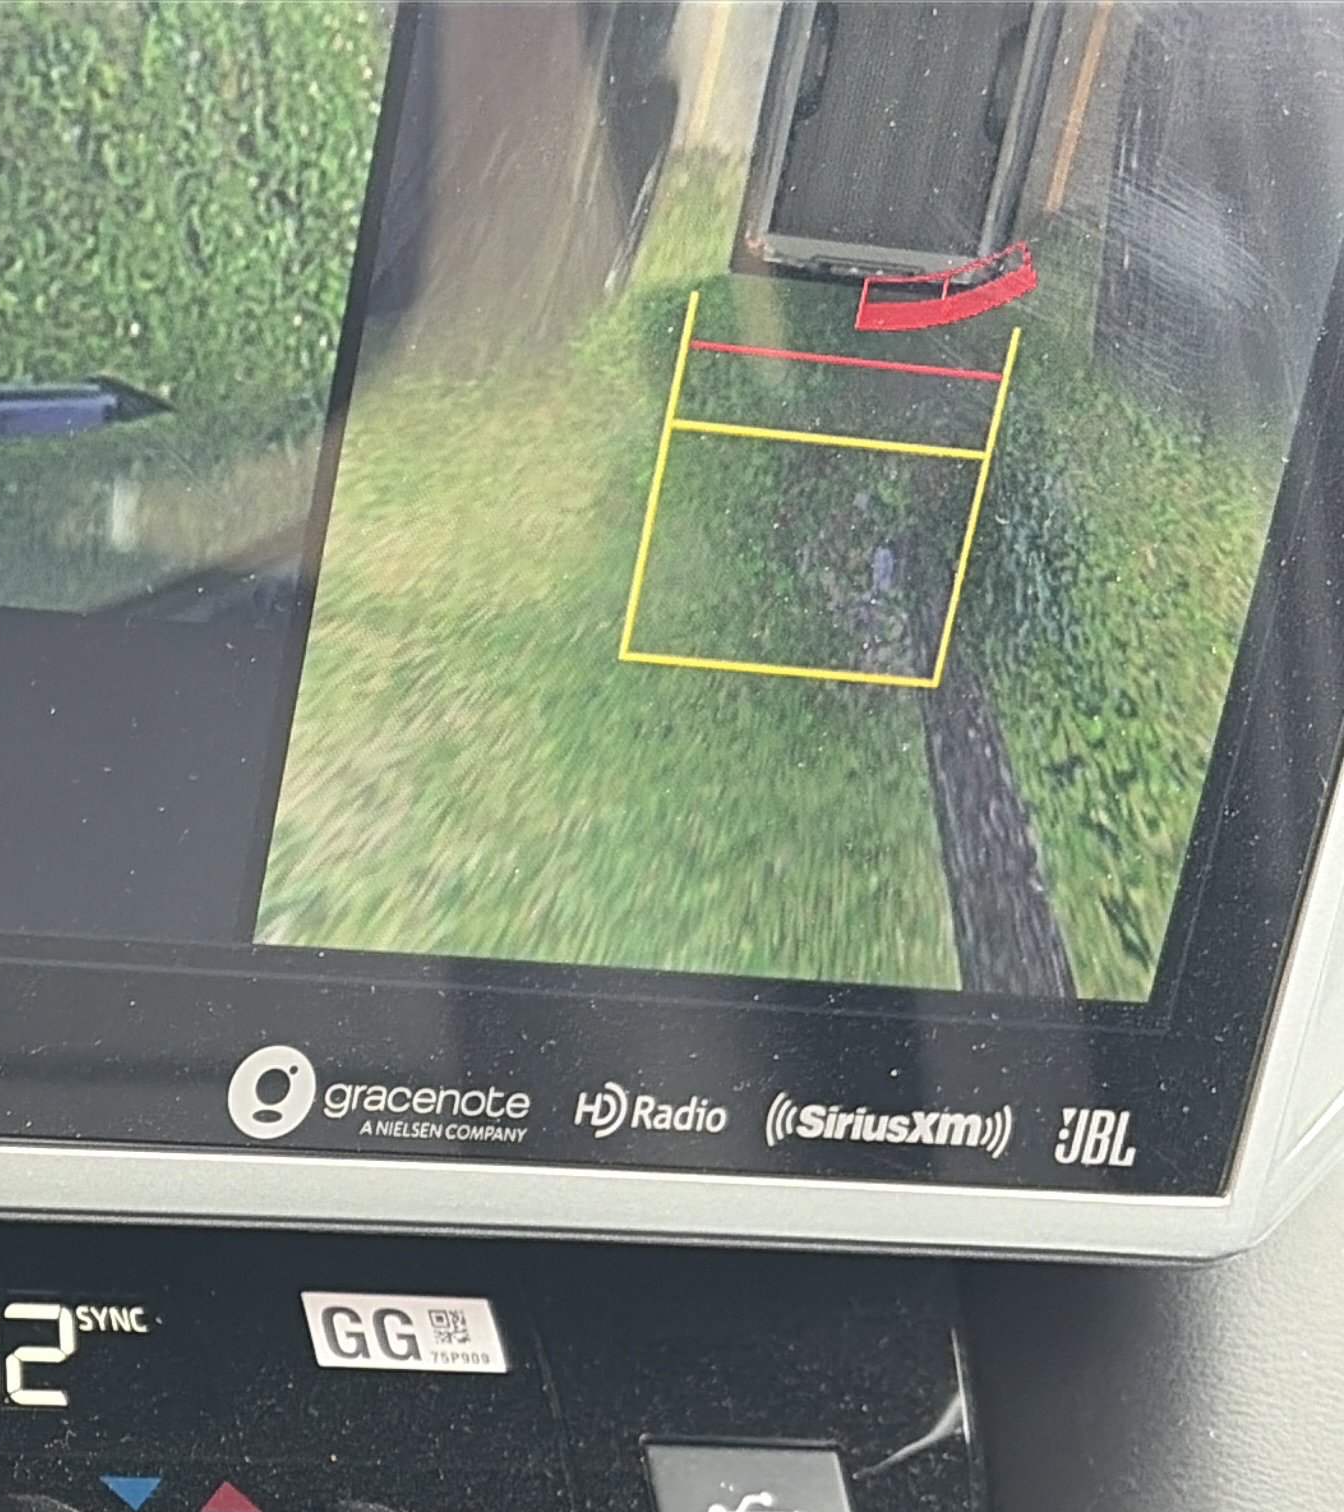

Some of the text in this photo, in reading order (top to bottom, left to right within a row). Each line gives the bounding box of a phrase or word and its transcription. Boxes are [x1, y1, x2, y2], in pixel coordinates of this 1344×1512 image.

[323, 1083, 531, 1119] gracenote
[630, 1095, 727, 1133] Radio
[359, 1120, 528, 1143] A NIELSEN COMPANY
[1054, 1107, 1137, 1167] JBL
[75, 1305, 148, 1333] SYNC
[321, 1305, 422, 1361] GG
